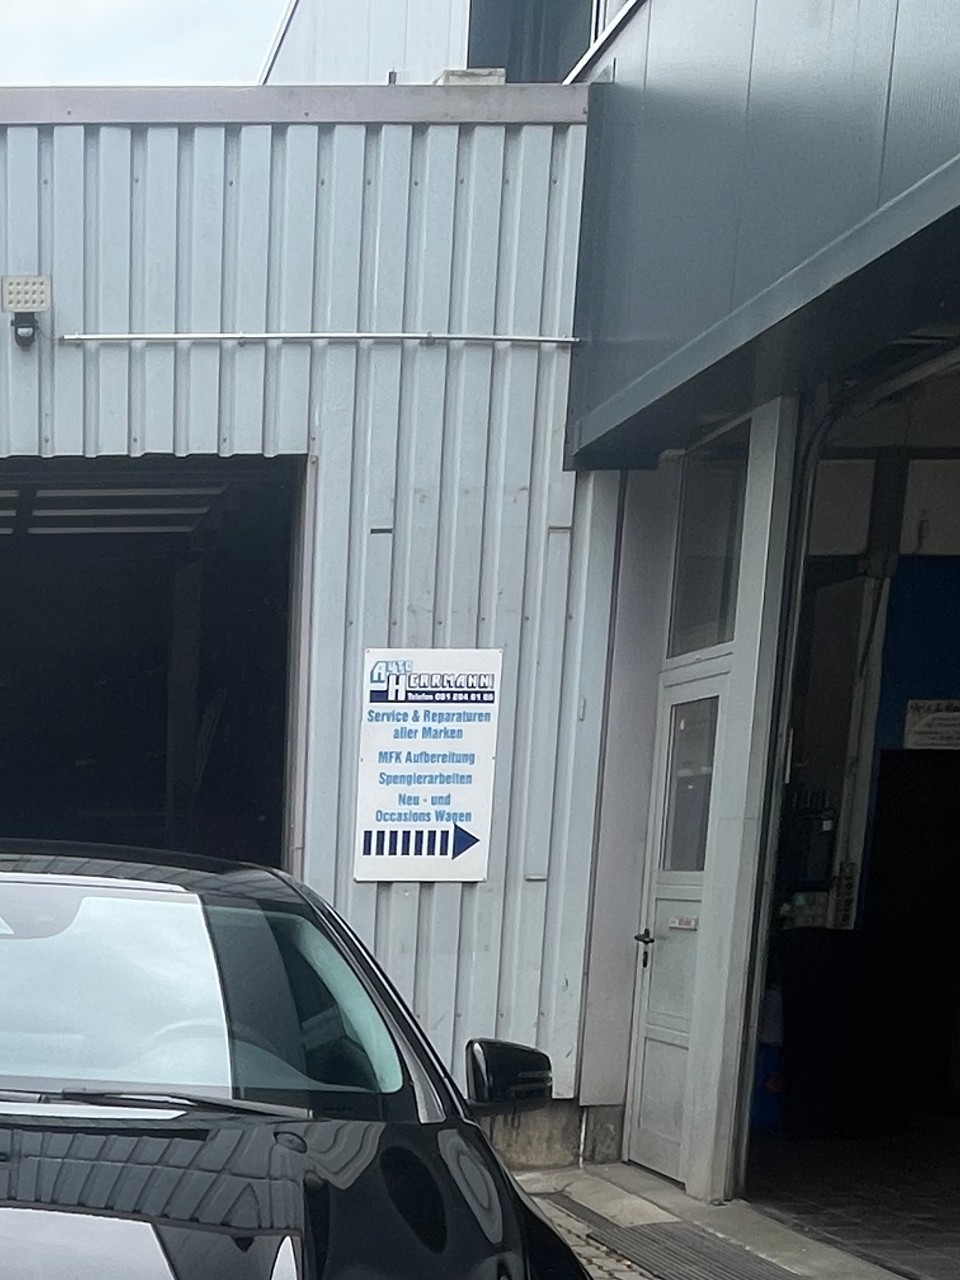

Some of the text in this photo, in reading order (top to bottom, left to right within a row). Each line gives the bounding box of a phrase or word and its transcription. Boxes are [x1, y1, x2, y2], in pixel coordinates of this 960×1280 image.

[387, 673, 489, 701] HERRMANN
[367, 709, 491, 724] Service & Reparaturen
[393, 727, 463, 739] aller Marken
[378, 751, 475, 765] MFK Aufbereitung
[379, 772, 473, 786] Spenglerarbeiten
[398, 794, 419, 806] Neu
[430, 794, 451, 806] und
[375, 810, 472, 823] Occasions Wagen
